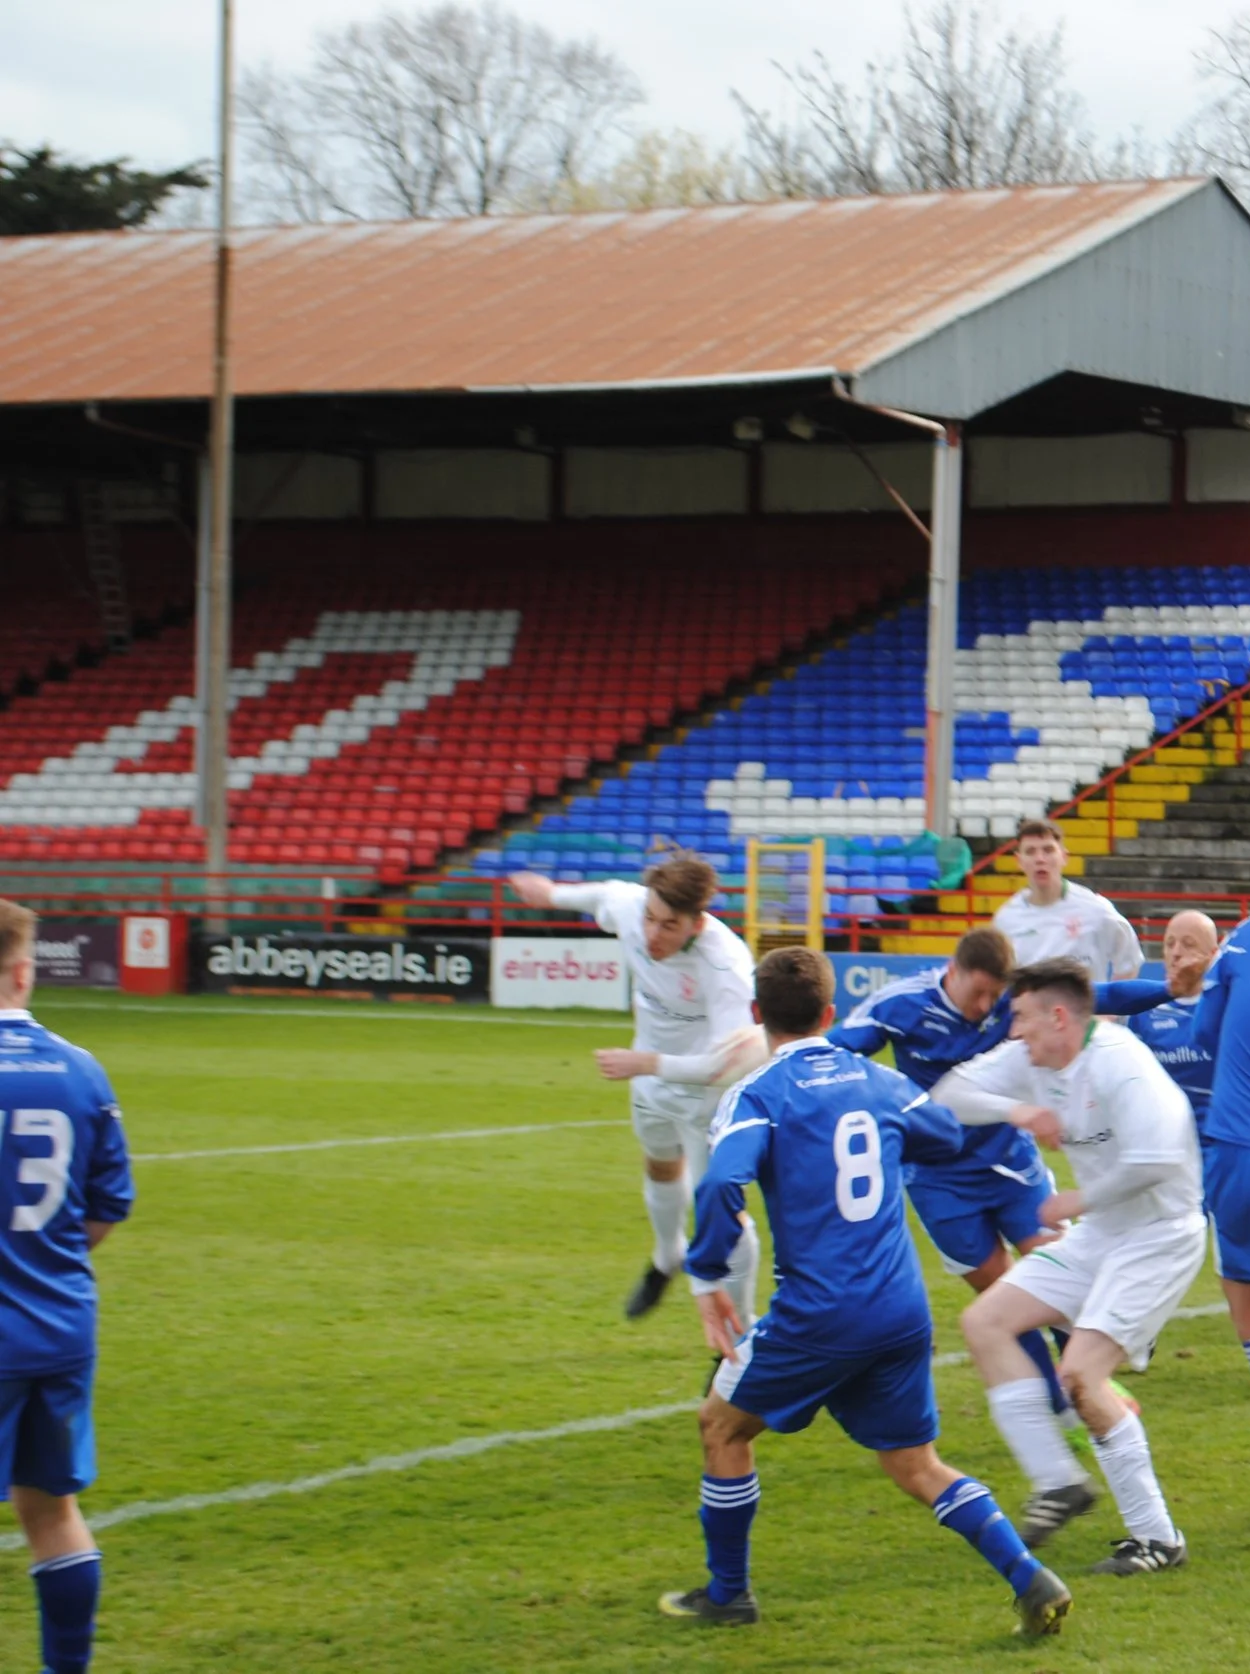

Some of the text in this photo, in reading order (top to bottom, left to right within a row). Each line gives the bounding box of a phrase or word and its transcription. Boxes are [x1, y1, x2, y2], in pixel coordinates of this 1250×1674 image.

[207, 936, 472, 986] abbeyseals.ie
[503, 950, 619, 981] eirebus
[0, 1108, 75, 1232] 3
[833, 1110, 885, 1223] 8
